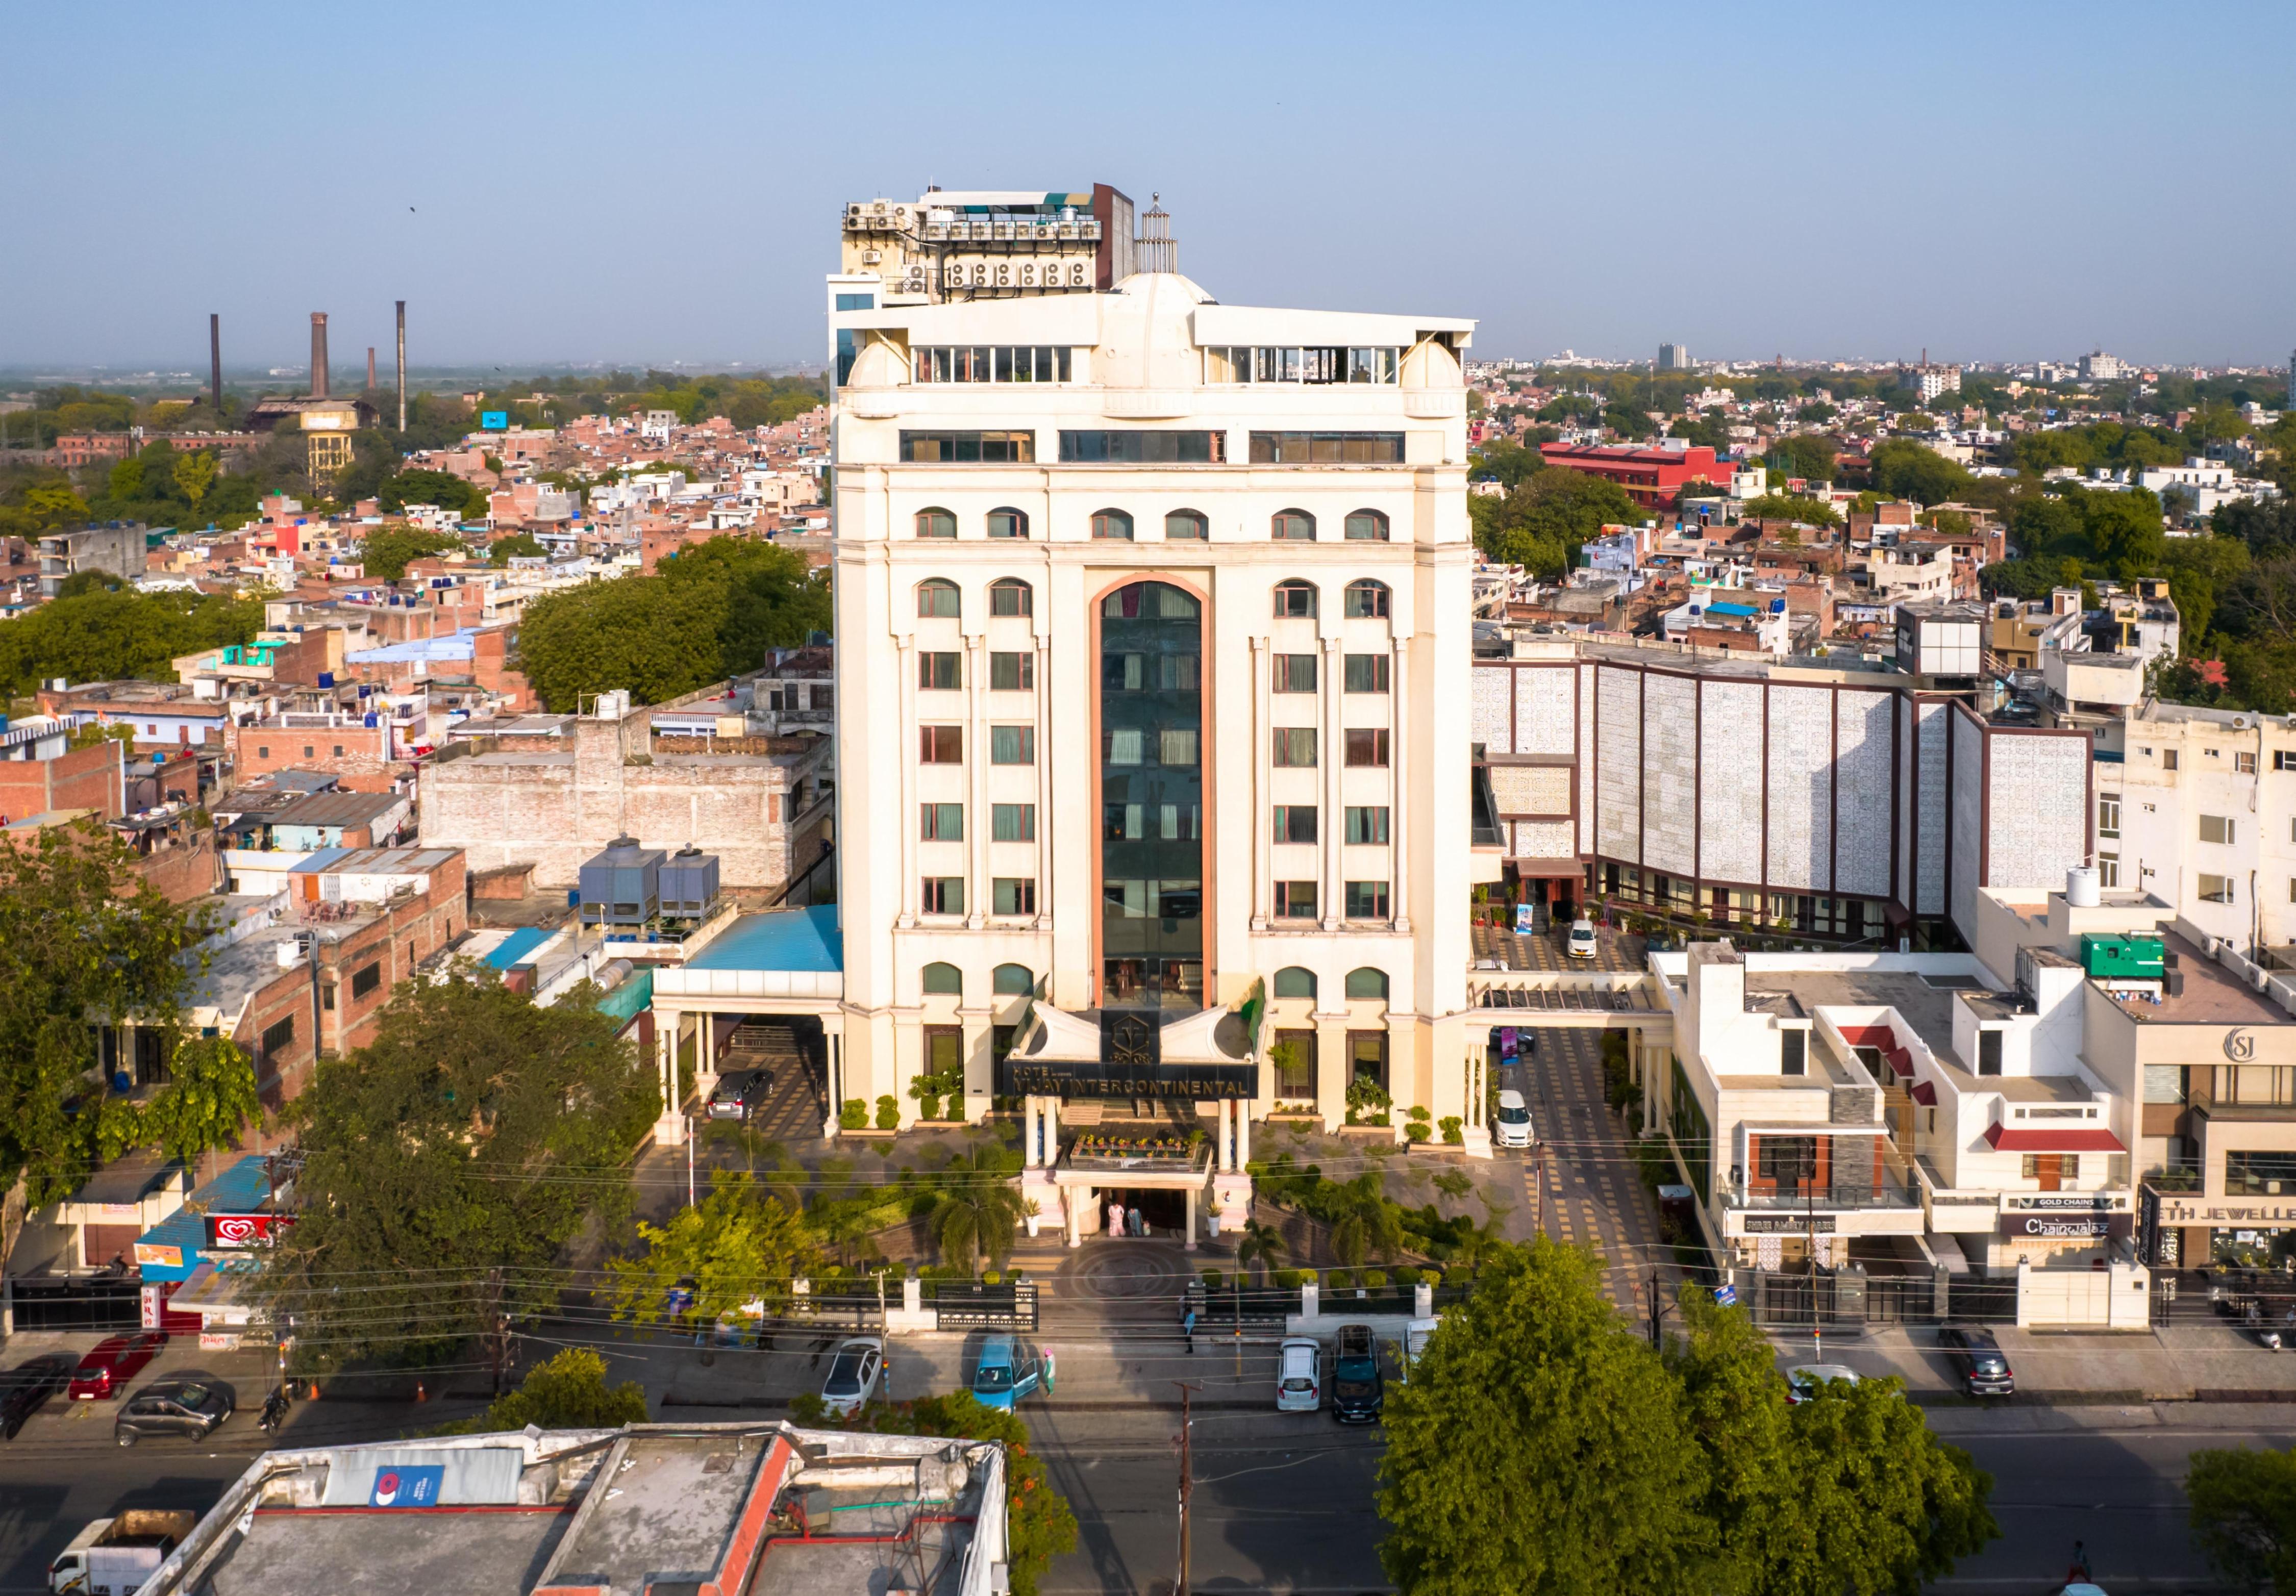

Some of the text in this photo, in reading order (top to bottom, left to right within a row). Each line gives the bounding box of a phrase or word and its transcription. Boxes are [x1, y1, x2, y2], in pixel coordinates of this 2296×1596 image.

[1013, 1066, 1057, 1077] HOTEL
[1014, 1079, 1247, 1095] VIJAY INTERCONTINENTAL
[2201, 1206, 2296, 1221] JEWELLE
[1746, 1221, 1772, 1230] SHREE
